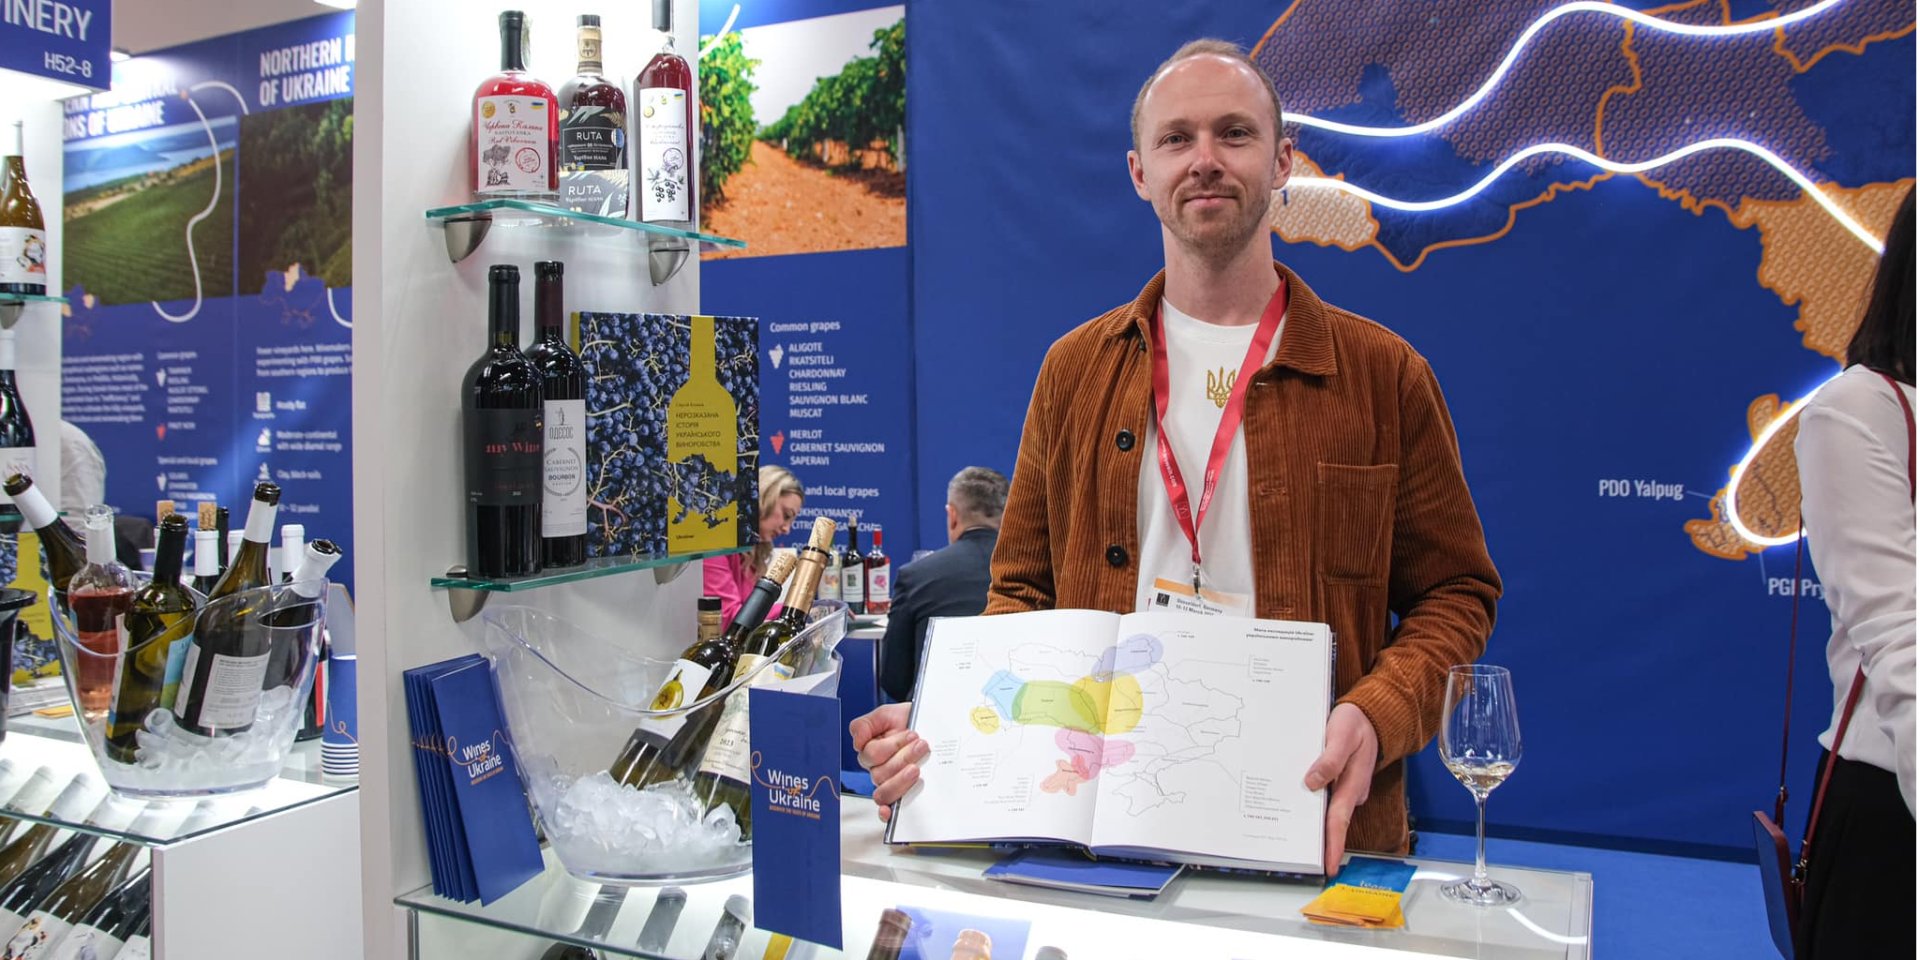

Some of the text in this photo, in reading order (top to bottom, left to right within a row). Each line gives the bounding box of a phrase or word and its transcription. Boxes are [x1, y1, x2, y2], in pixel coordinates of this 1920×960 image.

[0, 0, 92, 41] INERY
[259, 36, 342, 78] NORTHERN
[44, 51, 92, 78] H52-8
[259, 65, 351, 106] OF UKRAINE
[576, 131, 603, 141] RUTA
[568, 184, 602, 196] RUTA
[770, 321, 840, 334] Common grapes
[788, 342, 822, 352] ALIGOTE
[789, 355, 834, 366] RKATSITELI
[789, 368, 847, 378] CHARDONNAY
[790, 382, 827, 392] RIESLING
[790, 394, 868, 405] SAUVIGNON BLANC
[790, 408, 822, 418] MUSCAT
[790, 429, 822, 439] MERLOT
[790, 442, 885, 452] CABERNET SAUVIGNON
[790, 456, 830, 466] SAPERAVI
[544, 465, 578, 473] SAUVIGNON
[805, 486, 880, 499] and local grapes
[1598, 479, 1684, 500] PDO Yalpug
[1768, 578, 1796, 596] PGI
[462, 740, 491, 761] Wines
[468, 754, 502, 778] Ukraine
[767, 768, 808, 790] Wines
[769, 788, 820, 812] Ukraine
